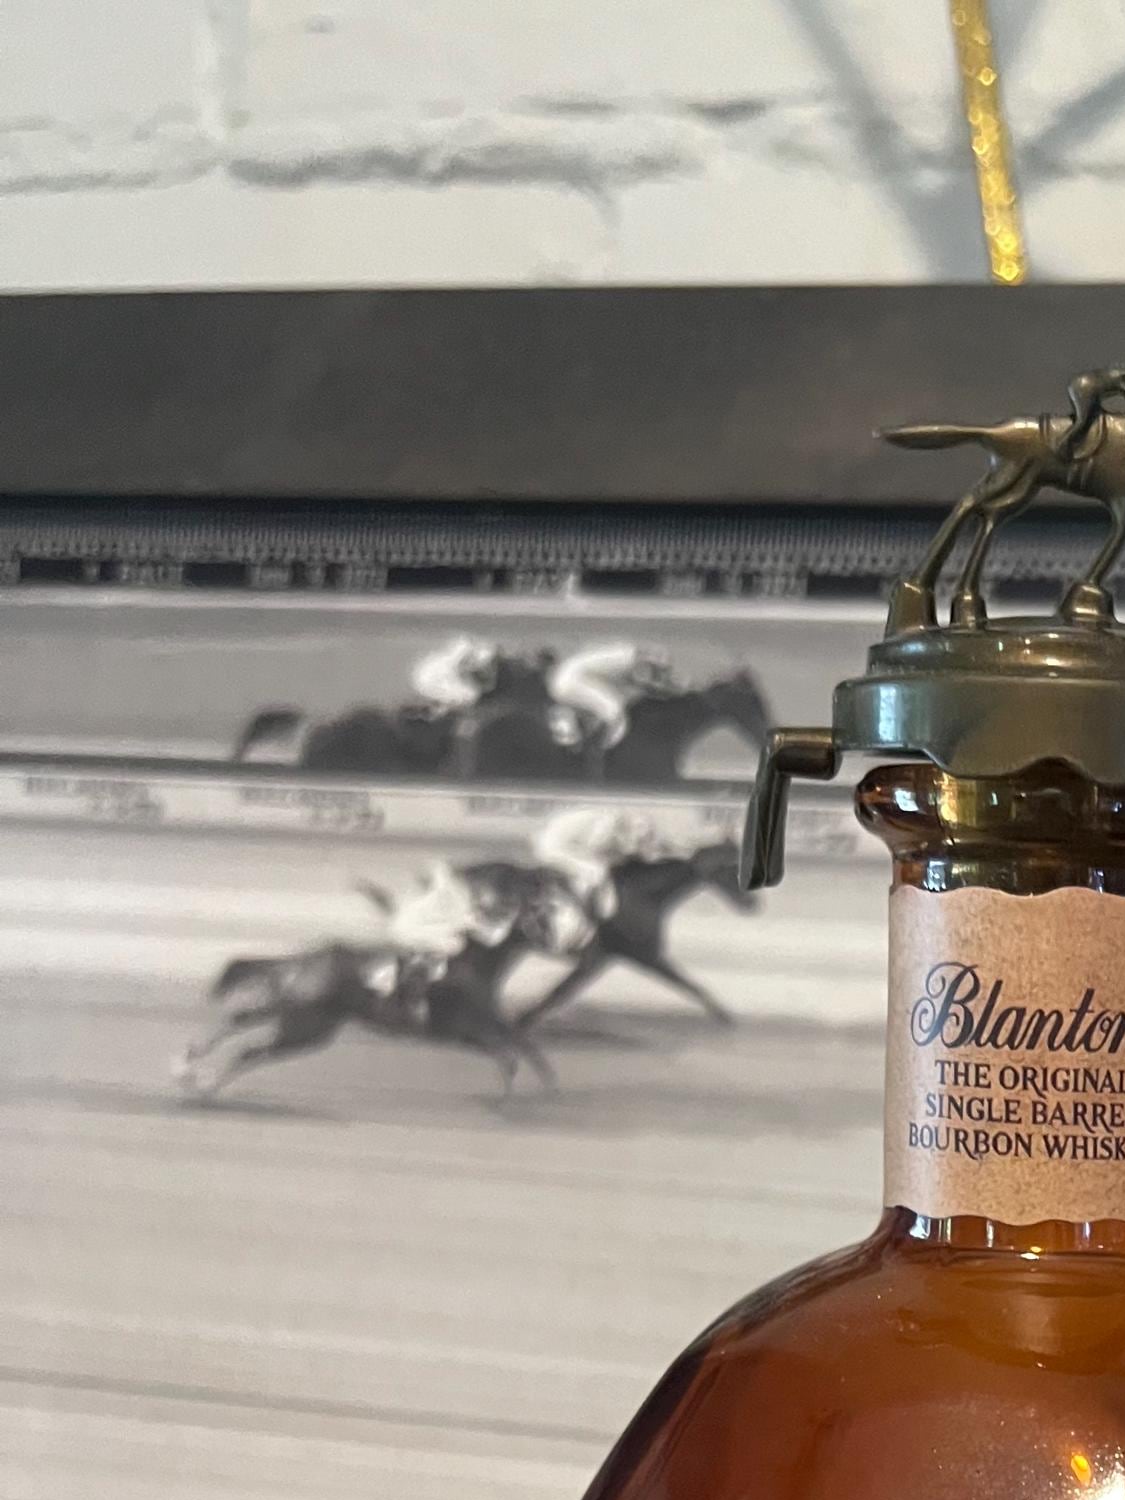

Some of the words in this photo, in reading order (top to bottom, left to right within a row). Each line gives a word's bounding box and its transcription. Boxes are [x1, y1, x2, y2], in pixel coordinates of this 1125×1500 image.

[934, 1059, 992, 1091] THE
[924, 1094, 1022, 1125] SINGLE
[907, 1122, 1033, 1159] BOURBON
